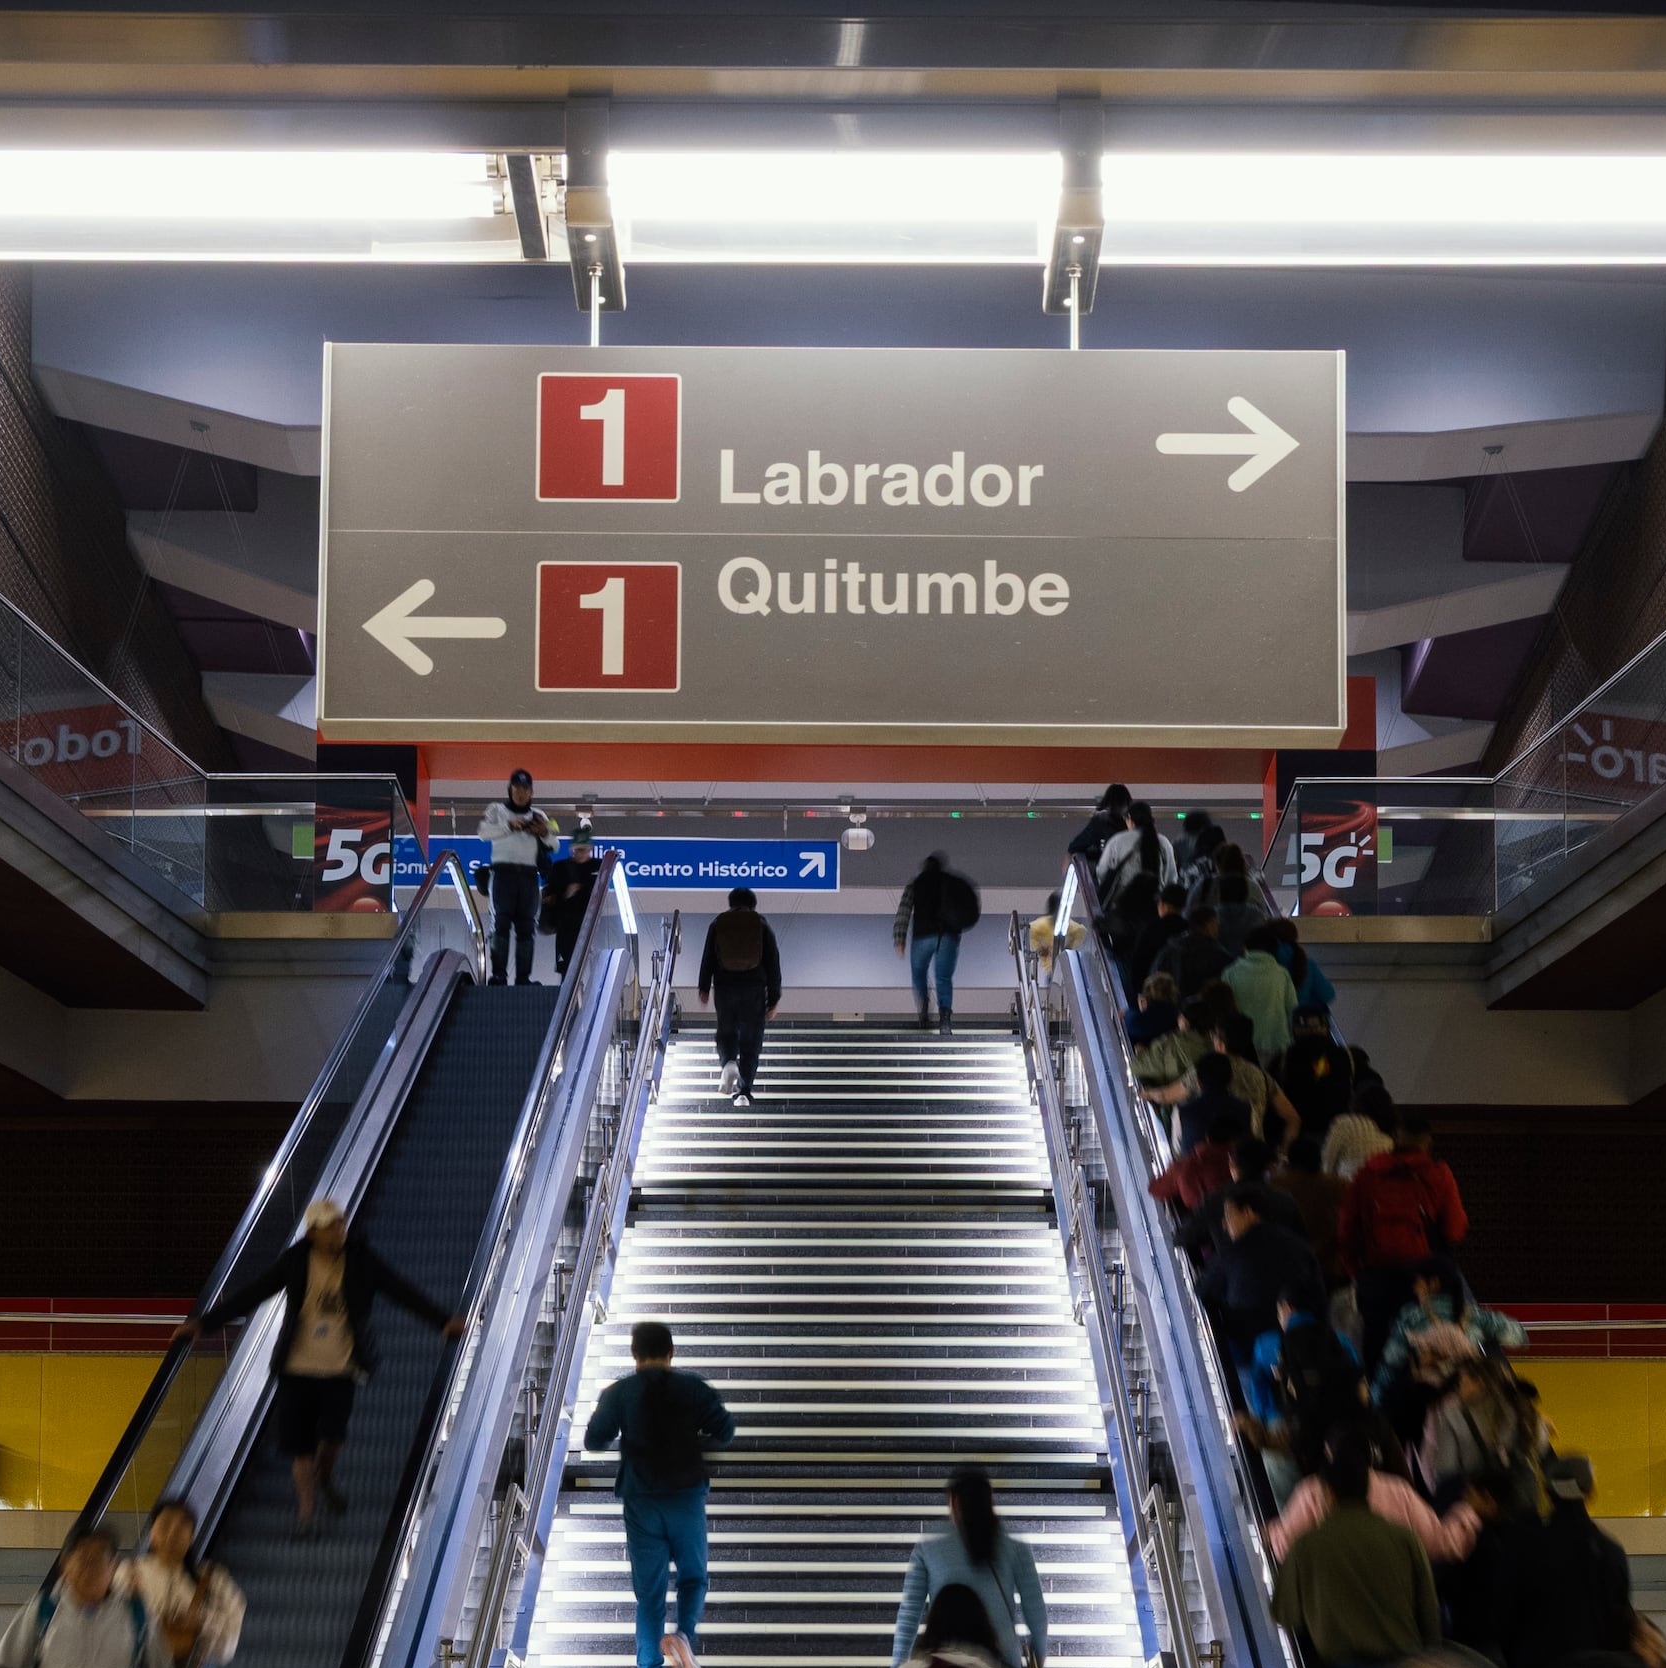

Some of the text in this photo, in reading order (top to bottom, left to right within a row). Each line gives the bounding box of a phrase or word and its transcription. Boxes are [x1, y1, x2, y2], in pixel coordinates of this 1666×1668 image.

[580, 389, 1044, 507] 1 Labrador
[580, 556, 1070, 674] 1 Quitumbe
[322, 829, 394, 885] 5G
[624, 861, 788, 878] Centro Histórico
[1281, 832, 1359, 889] 5G
